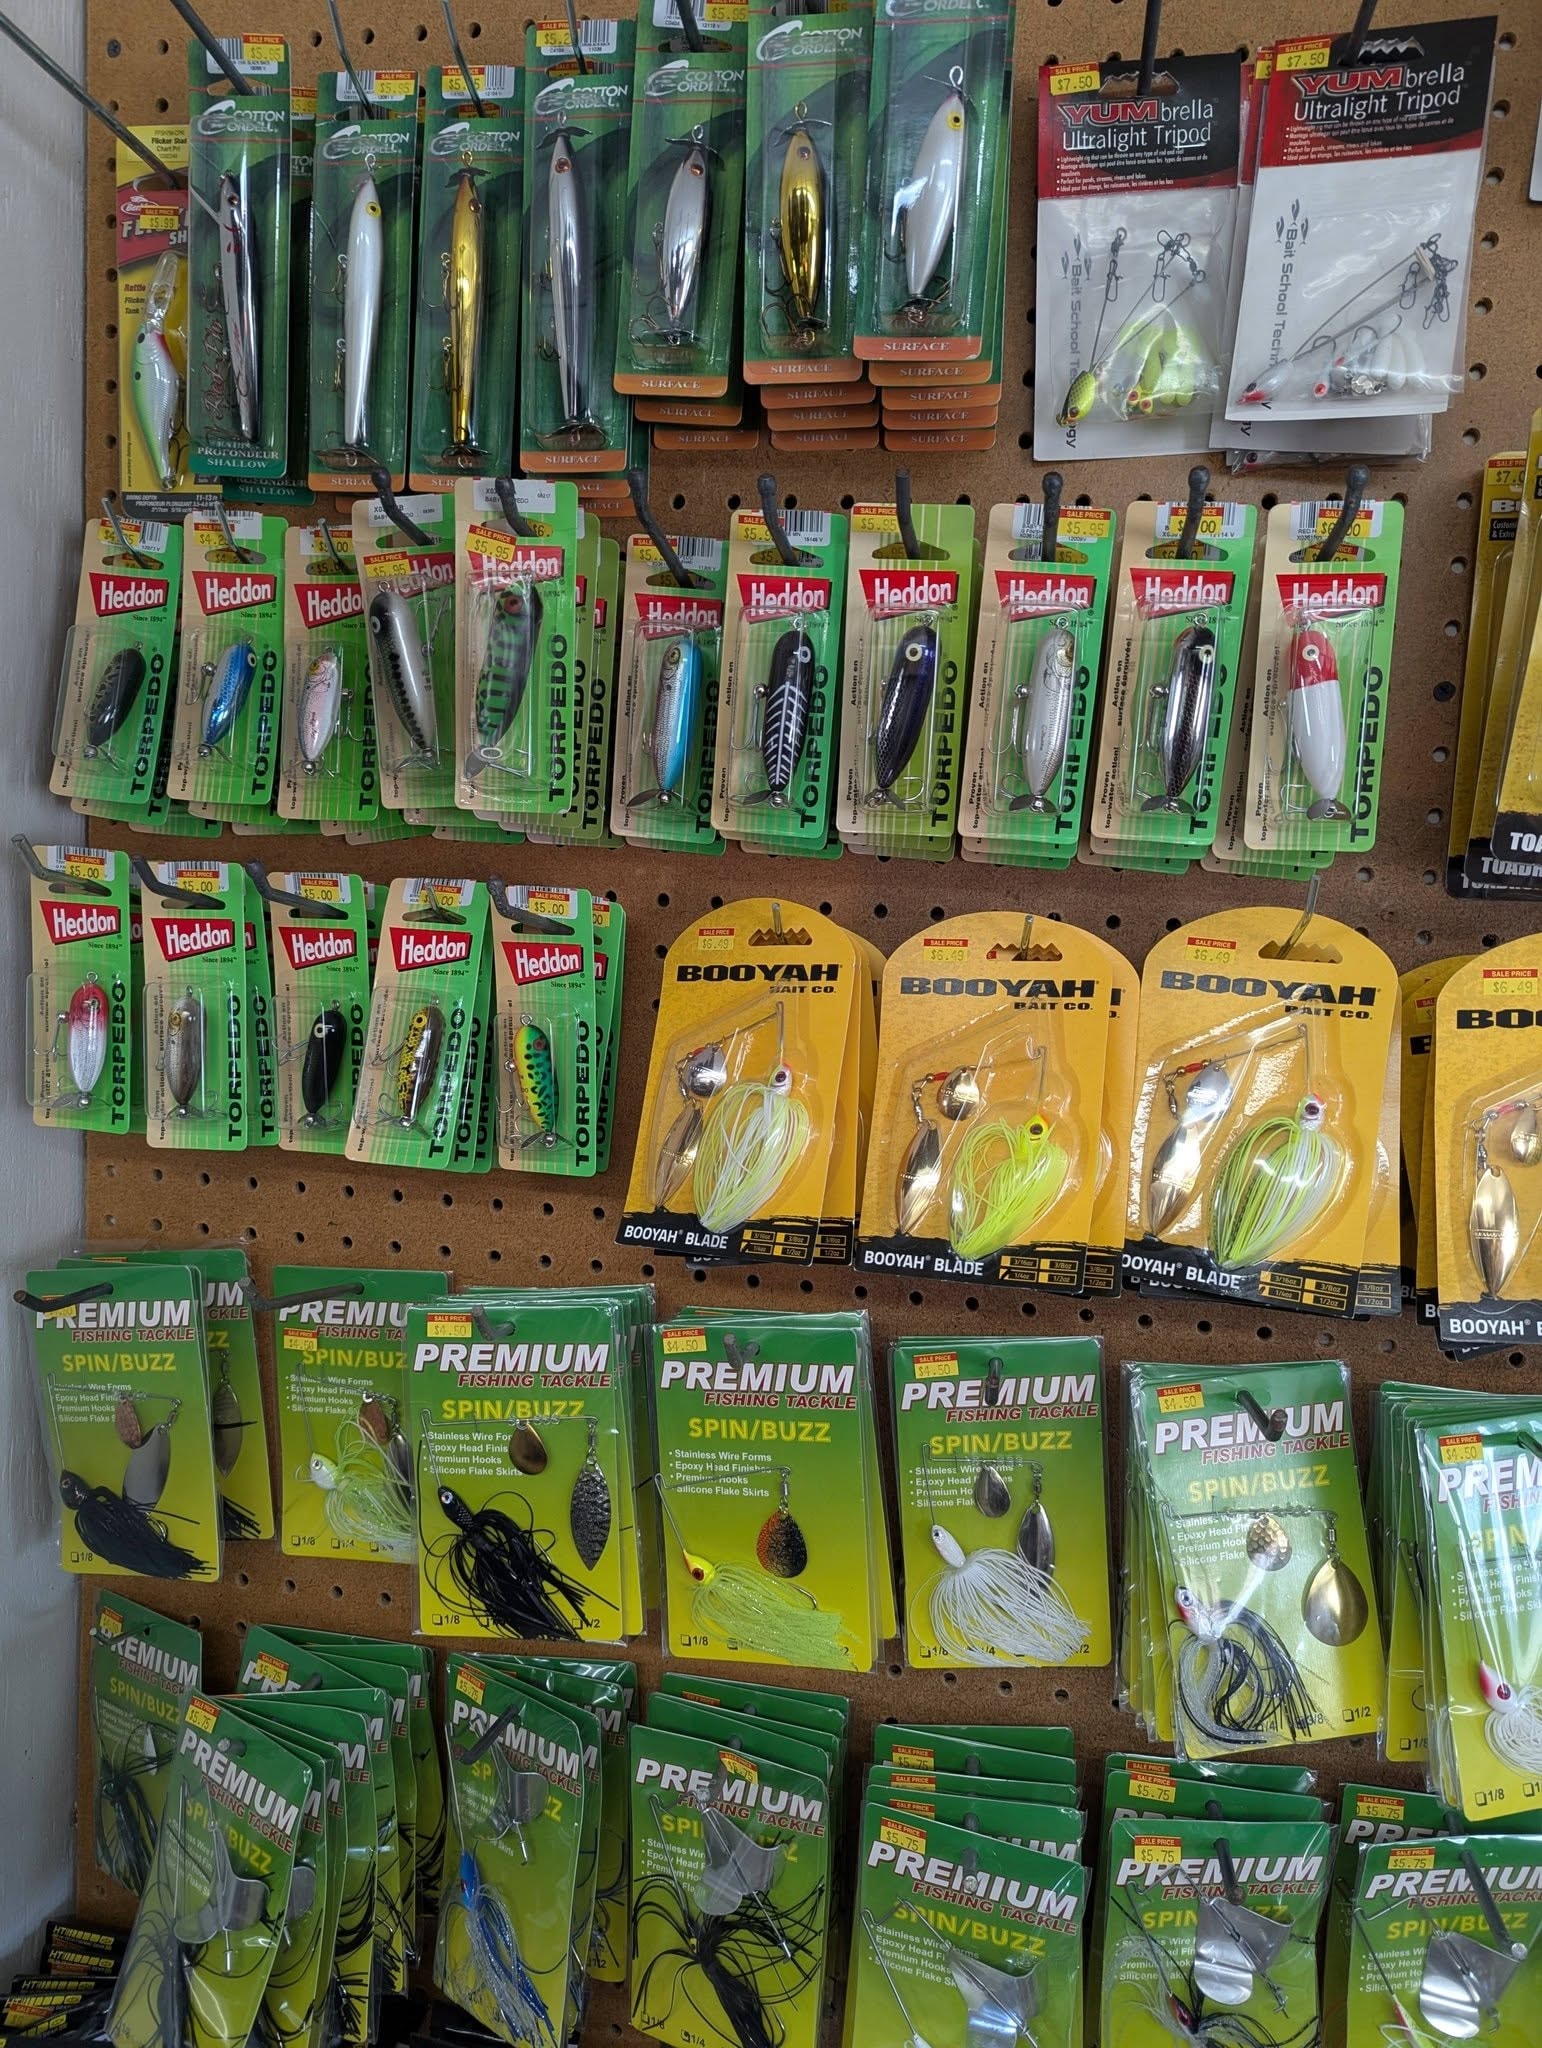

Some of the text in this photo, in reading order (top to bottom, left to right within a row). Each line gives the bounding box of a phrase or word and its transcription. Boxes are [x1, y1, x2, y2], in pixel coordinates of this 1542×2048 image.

[711, 7, 746, 20] $5.95
[249, 35, 264, 43] SALE
[250, 46, 281, 60] $5.95
[1287, 52, 1325, 69] $7.50
[1055, 63, 1091, 75] SALE PRICE
[379, 82, 410, 94] $5.95
[1058, 75, 1093, 91] $7.50
[1294, 85, 1461, 124] Ultralight Tripod
[232, 111, 285, 122] COTTON
[1063, 123, 1212, 151] Ultralight Tripod
[149, 218, 174, 229] $5.99
[1070, 263, 1083, 297] Bait
[1276, 228, 1298, 316] Bait School
[124, 284, 146, 292] Rattle
[1068, 300, 1082, 354] School
[883, 341, 951, 352] SURFACE
[770, 363, 833, 374] SURFACE
[899, 366, 964, 377] SURFACE
[641, 379, 703, 390] SURFACE
[909, 390, 973, 401] SURFACE
[207, 458, 269, 469] SHALLOW
[545, 455, 601, 465] SURFACE
[1066, 510, 1105, 519] SALE PRICE
[476, 526, 512, 544] SALE PRICE
[1066, 520, 1105, 536] $5.95
[474, 539, 511, 560] $5.95
[100, 580, 164, 611] Heddon
[206, 577, 272, 611] Heddon
[752, 582, 825, 617] Heddon
[874, 576, 953, 610] Heddon
[1010, 578, 1088, 614] Heddon
[1292, 578, 1379, 610] Heddon
[648, 601, 719, 635] Heddon
[131, 652, 165, 796] TORPEDO
[251, 650, 277, 796] TORPEDO
[549, 634, 569, 802] TORPEDO
[582, 678, 606, 829] TORPEDO
[800, 665, 829, 828] TORPEDO
[1350, 665, 1383, 843] TORPEDO
[69, 864, 100, 879] $5.00
[182, 879, 213, 893] $5.00
[304, 887, 333, 901] $5.00
[535, 892, 567, 901] SALE PRICE
[534, 901, 565, 916] $5.00
[52, 908, 117, 938] Heddon
[166, 924, 231, 956] Heddon
[292, 933, 353, 964] Heddon
[400, 935, 467, 965] Heddon
[930, 949, 964, 961] $6.49
[1193, 948, 1231, 964] $6.49
[515, 948, 580, 978] Heddon
[676, 964, 840, 982] BOOYAH
[769, 985, 837, 994] BAIT CO.
[900, 976, 1096, 998] BOOYAH
[1160, 969, 1378, 1007] BOOYAH
[1493, 980, 1533, 994] $6.49
[1014, 1002, 1094, 1010] BAIT CO.
[1339, 1009, 1374, 1020] CO.
[111, 982, 127, 1126] TORPEDO
[228, 994, 243, 1142] TORPEDO
[576, 1019, 591, 1167] TORPEDO
[684, 1231, 729, 1250] BLADE
[933, 1257, 985, 1277] BLADE
[1185, 1266, 1241, 1289] BLADE
[72, 1327, 195, 1344] FISHING TACKLE
[433, 1324, 467, 1336] $4.50
[666, 1339, 699, 1353] $4.50
[62, 1353, 177, 1373] SPIN/BUZZ
[413, 1342, 610, 1373] PREMIUM
[660, 1360, 856, 1395] PREMIUM
[918, 1363, 951, 1376] $4.50
[457, 1373, 612, 1388] FISHING TACKLE
[441, 1399, 585, 1420] SPIN/BUZZ
[703, 1391, 857, 1410] FISHING TACKLE
[1164, 1396, 1198, 1411] $4.50
[946, 1404, 1098, 1424] FISHING TACKLE
[688, 1416, 833, 1443] SPIN/BUZZ
[929, 1430, 1073, 1456] SPIN/BUZZ
[1202, 1432, 1351, 1465] FISHING TACKLE
[674, 1449, 772, 1462] Stainless Wire Forms
[1446, 1446, 1478, 1461] $4.50
[468, 1466, 494, 1475] Flake
[496, 1467, 523, 1476] Skirts
[675, 1461, 704, 1473] Epoxy
[705, 1462, 730, 1472] Head
[676, 1485, 770, 1497] Silicone Flake Skirts
[1187, 1463, 1331, 1504] SPIN/BUZZ
[80, 1552, 93, 1563] 1/8
[444, 1614, 461, 1625] 1/8
[692, 1635, 709, 1646] 1/8
[188, 1709, 213, 1731] $5.75
[1354, 1706, 1372, 1719] 1/2
[180, 1728, 300, 1836] PREMIUM
[1136, 1784, 1171, 1801] $5.75
[1487, 1788, 1505, 1802] 1/8
[755, 1810, 826, 1838] TACKLE
[886, 1830, 920, 1852] $5.75
[1140, 1849, 1175, 1863] $5.75
[1392, 1857, 1427, 1869] $5.75
[866, 1840, 1079, 1921] PREMIUM
[912, 1880, 1079, 1936] FISHING TACKLE
